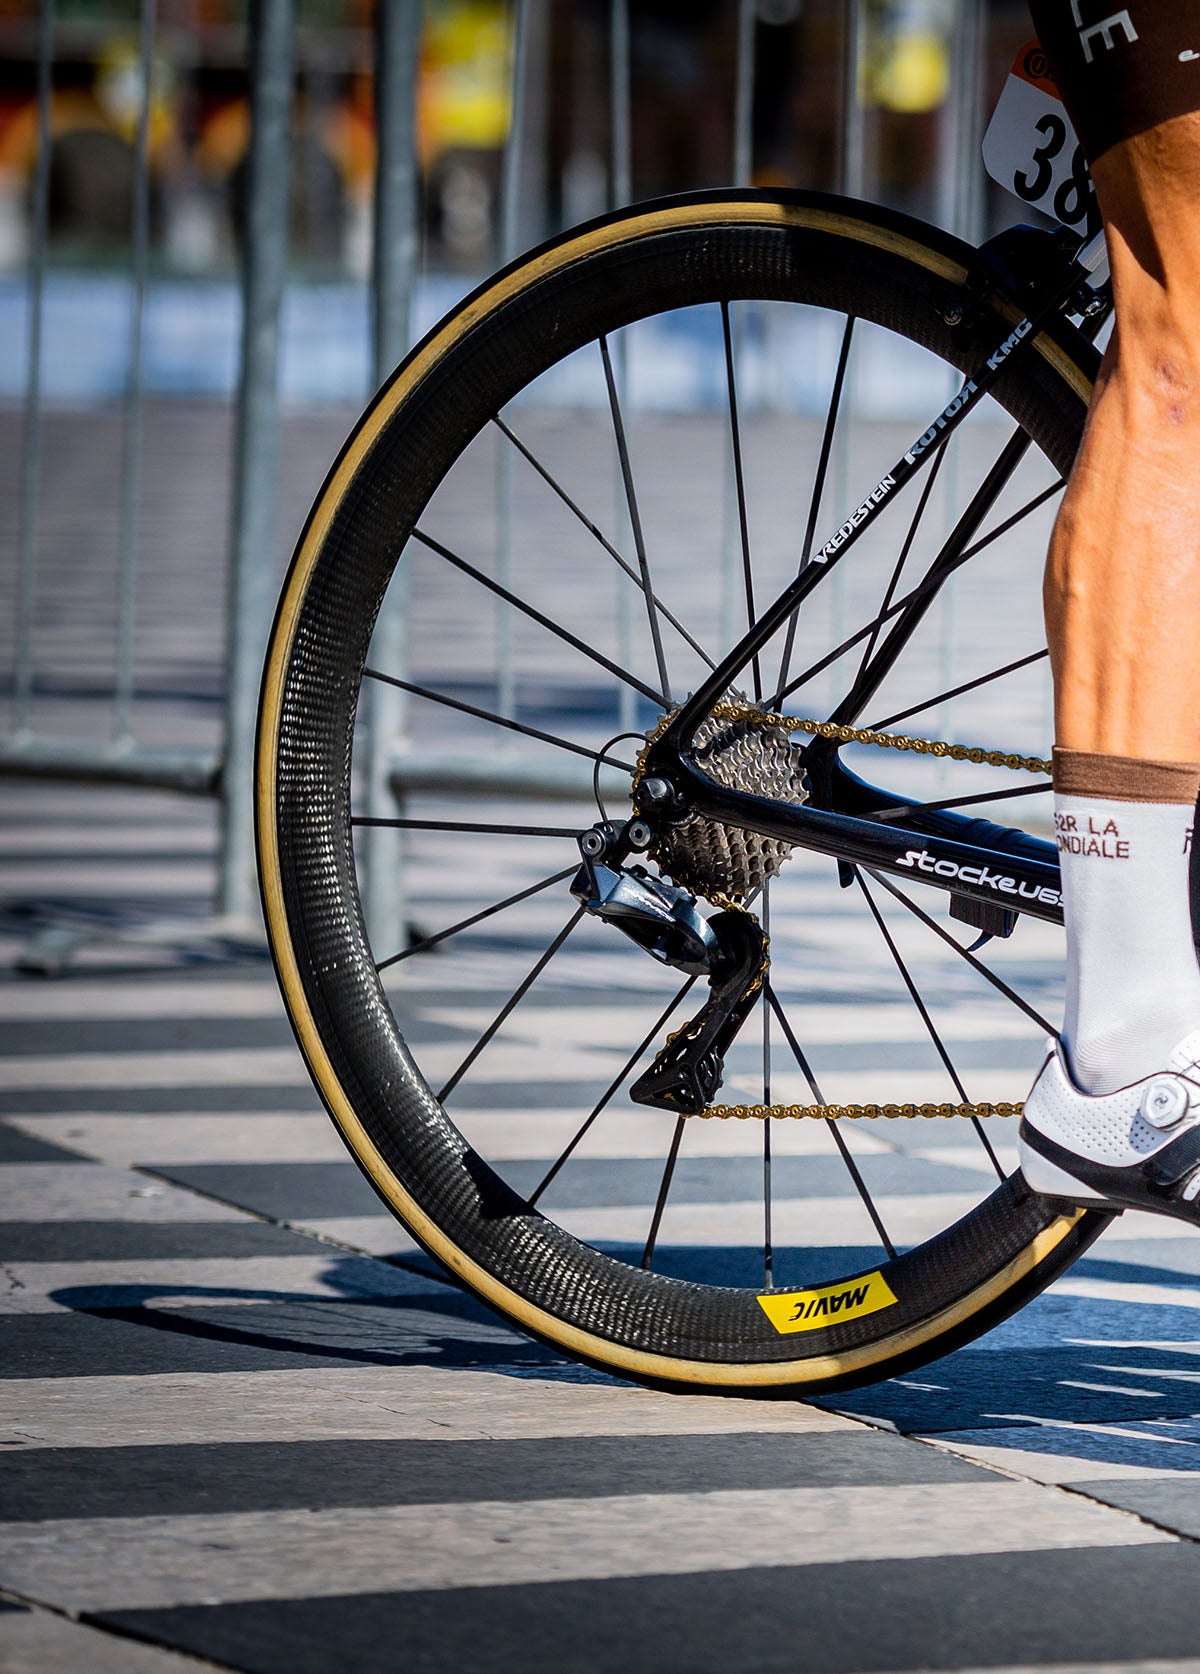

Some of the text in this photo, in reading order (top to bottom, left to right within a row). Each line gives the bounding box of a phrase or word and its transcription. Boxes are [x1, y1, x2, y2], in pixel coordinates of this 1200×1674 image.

[986, 318, 1033, 371] KMC
[903, 379, 978, 465] ROTOR
[813, 474, 897, 565] VREDESTEIN
[1089, 816, 1119, 837] LA
[895, 850, 1064, 907] stockeu6
[788, 1284, 871, 1321] MAVIC
